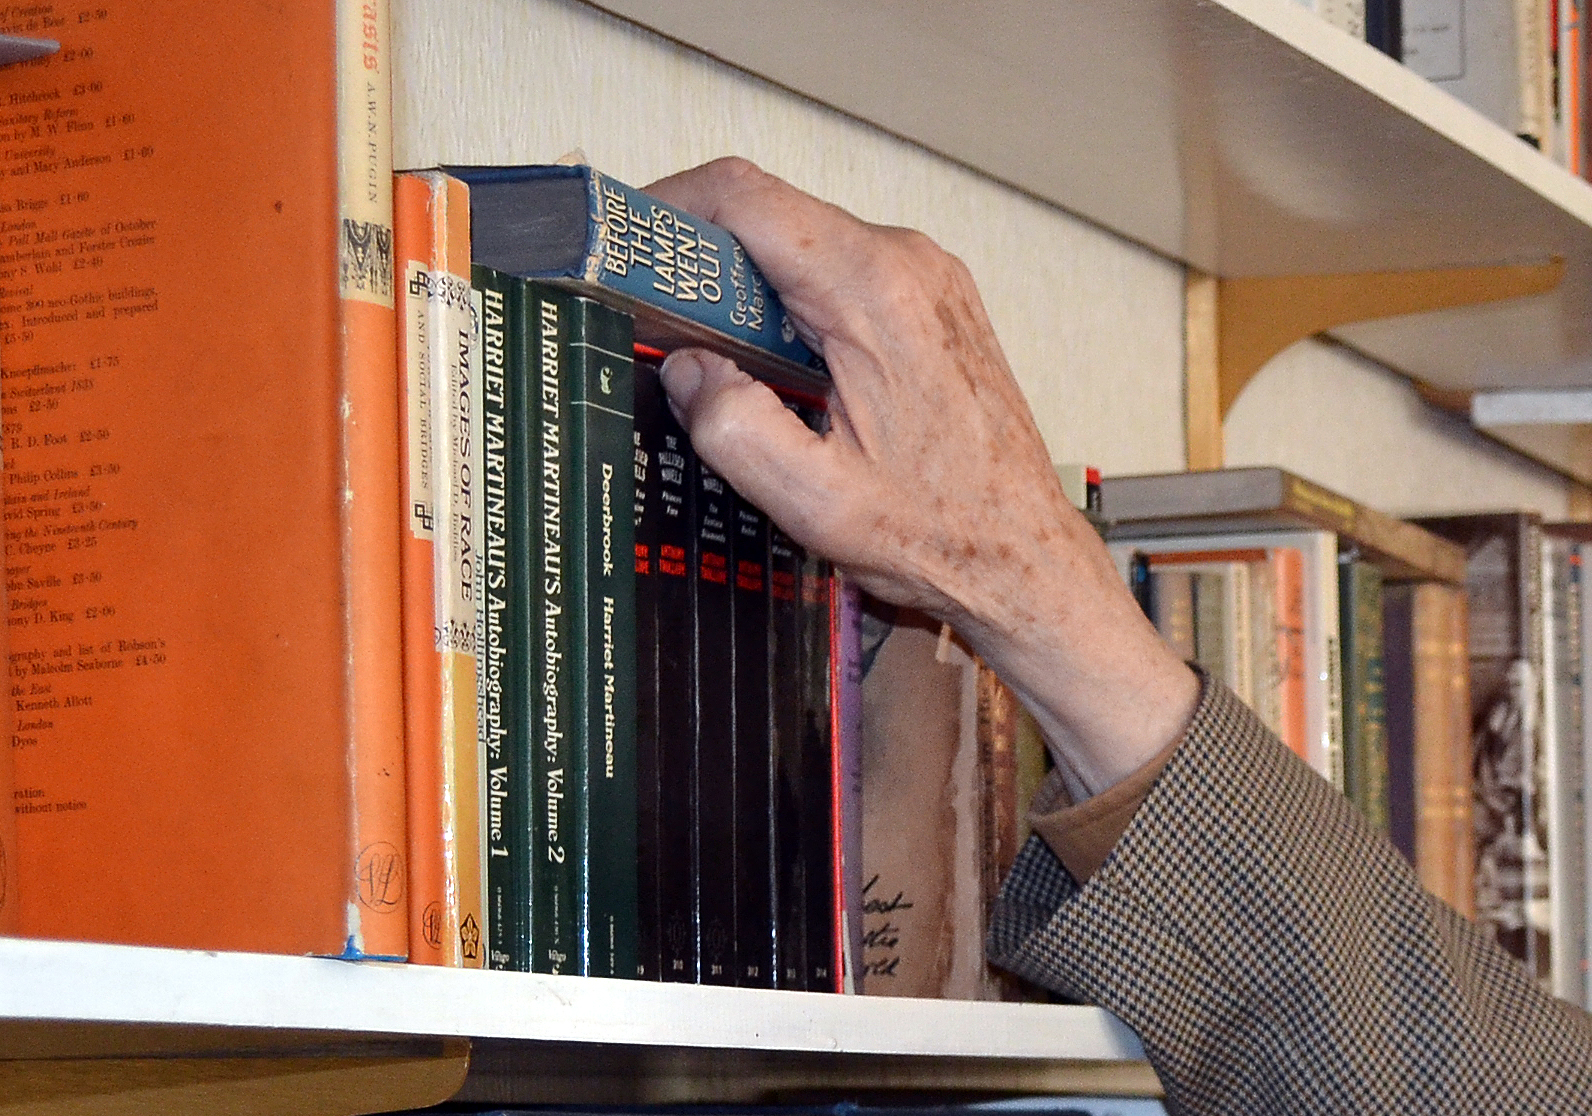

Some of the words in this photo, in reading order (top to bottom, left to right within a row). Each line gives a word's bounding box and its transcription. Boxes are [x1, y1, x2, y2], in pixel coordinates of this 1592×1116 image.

[603, 183, 629, 277] BEFORE
[627, 206, 652, 268] THE
[650, 205, 677, 296] LAMPS
[673, 213, 700, 301] WENT
[698, 232, 722, 304] OUT
[729, 239, 748, 326] Geoffrey
[747, 269, 765, 331] Marc
[417, 310, 426, 344] AND
[485, 288, 505, 410] HARRIET
[541, 299, 559, 418] HARRIET
[418, 351, 428, 409] SOCIAL
[458, 329, 471, 458] IMAGES
[419, 418, 429, 490] BRIDGES
[460, 463, 472, 509] OF
[486, 411, 507, 588] MARTINEAU'S
[542, 420, 562, 595] MARTINEAU'S
[602, 463, 613, 578] Deerbrook
[460, 513, 473, 602] RACE
[475, 549, 484, 601] John
[50, 610, 75, 624] King
[603, 596, 614, 671] Harriet
[475, 607, 486, 744] Hollingshead
[486, 599, 508, 760] Autobiography:
[543, 599, 564, 764] Autobiography:
[603, 672, 616, 779] Martineau
[490, 766, 508, 841] Volume
[547, 767, 564, 843] Volume
[491, 846, 509, 858] 1
[548, 845, 566, 865] 2
